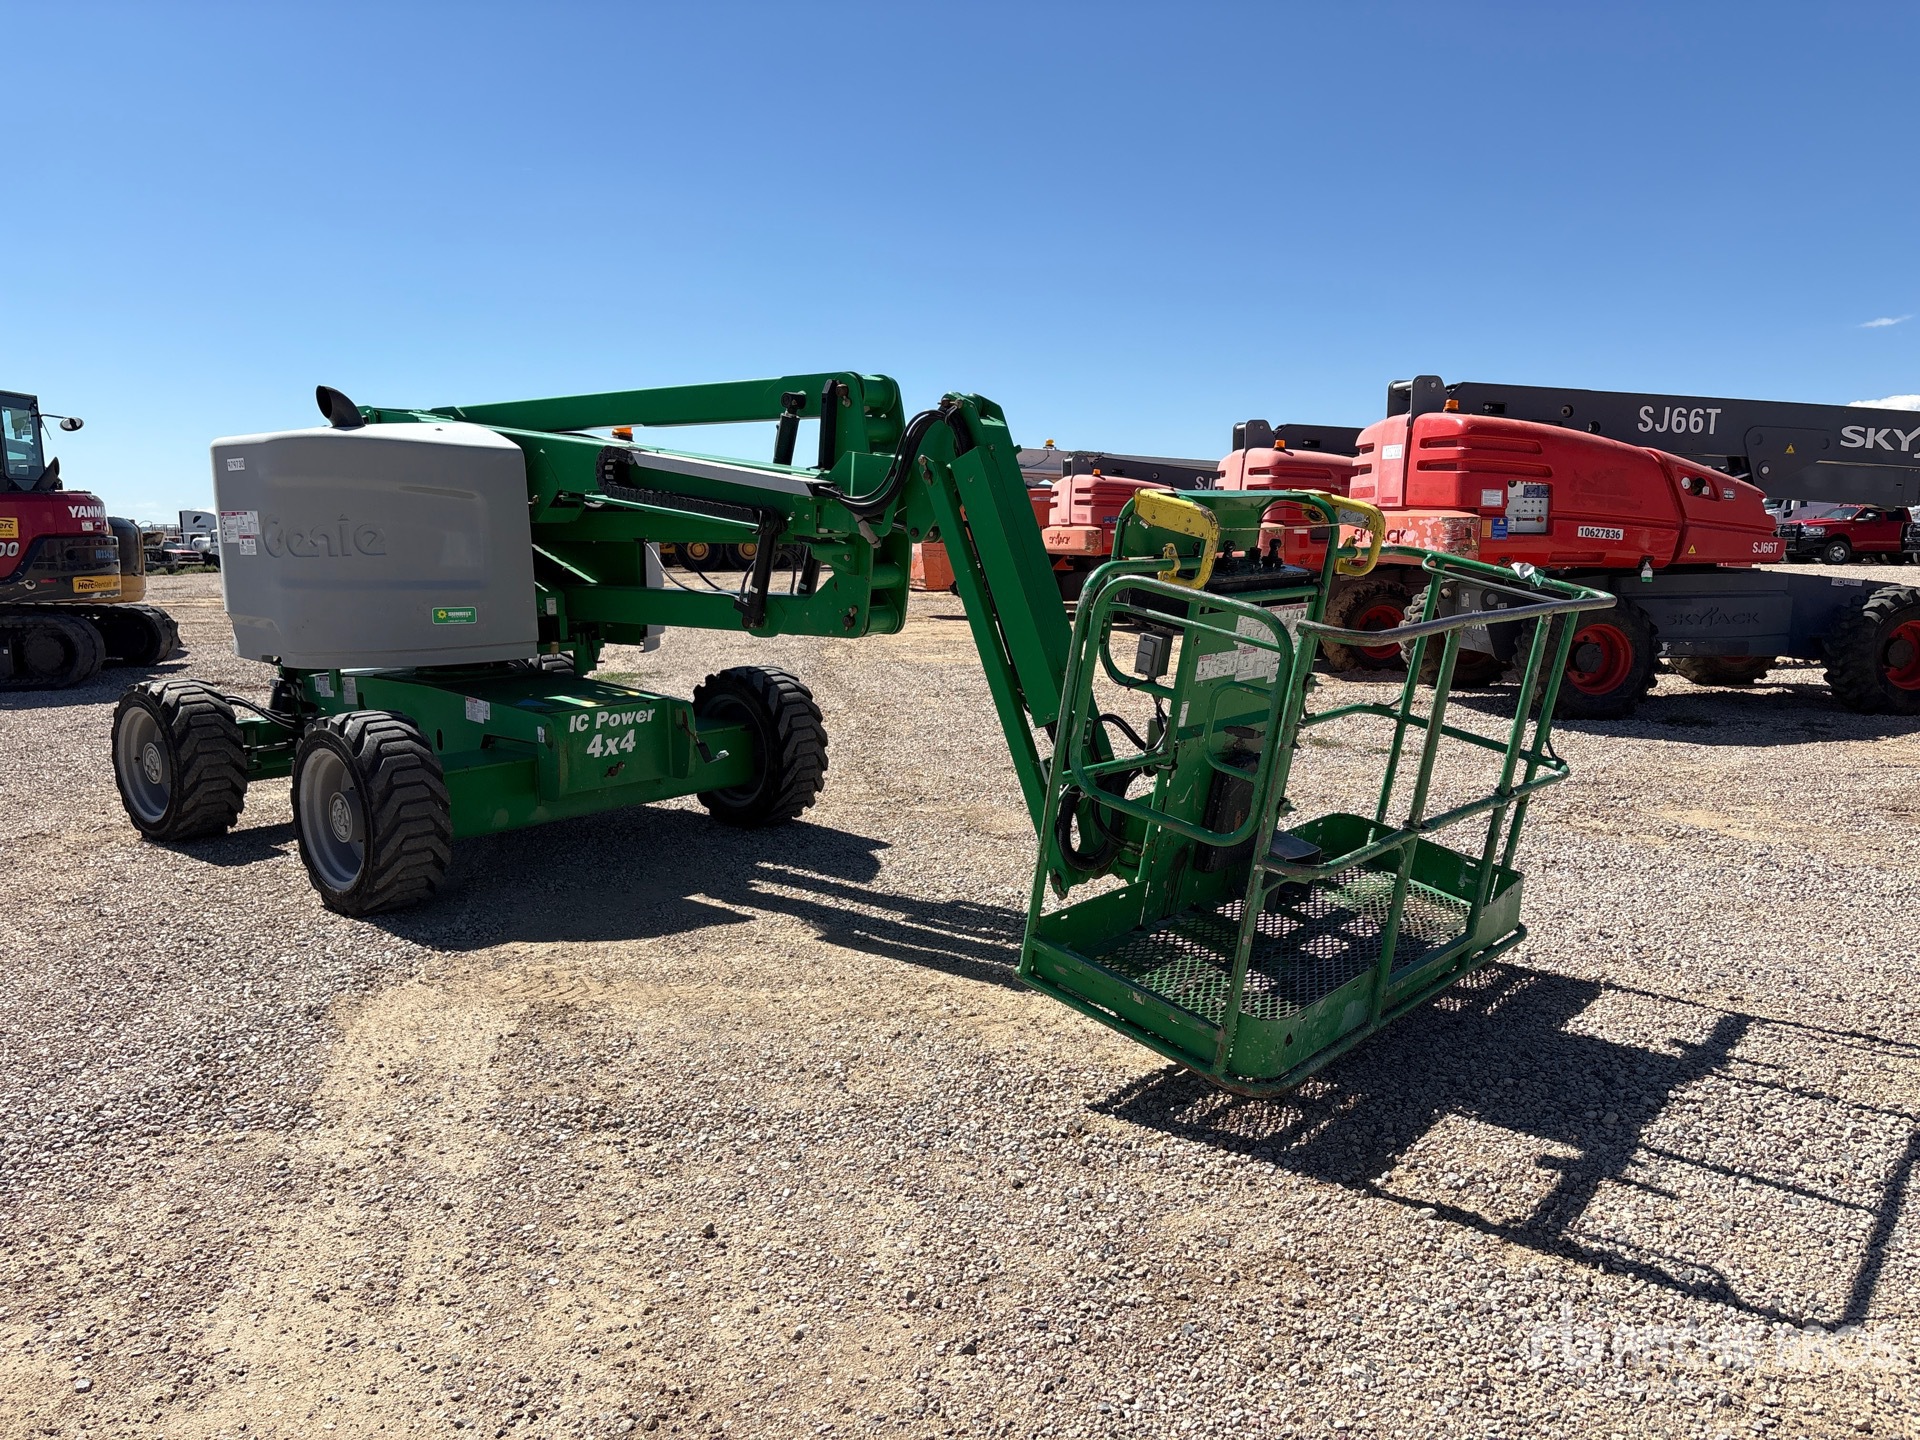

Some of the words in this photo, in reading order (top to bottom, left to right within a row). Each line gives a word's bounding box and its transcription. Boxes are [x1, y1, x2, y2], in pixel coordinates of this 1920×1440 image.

[1637, 405, 1722, 435] SJ66T
[1840, 425, 1920, 458] SKY
[262, 513, 387, 558] Genie
[1579, 527, 1621, 539] 10627836
[1752, 541, 1778, 553] SJ66T
[1666, 607, 1760, 628] SKYJACK
[569, 713, 590, 733] IC
[595, 708, 656, 730] Power
[586, 729, 636, 758] 4x4
